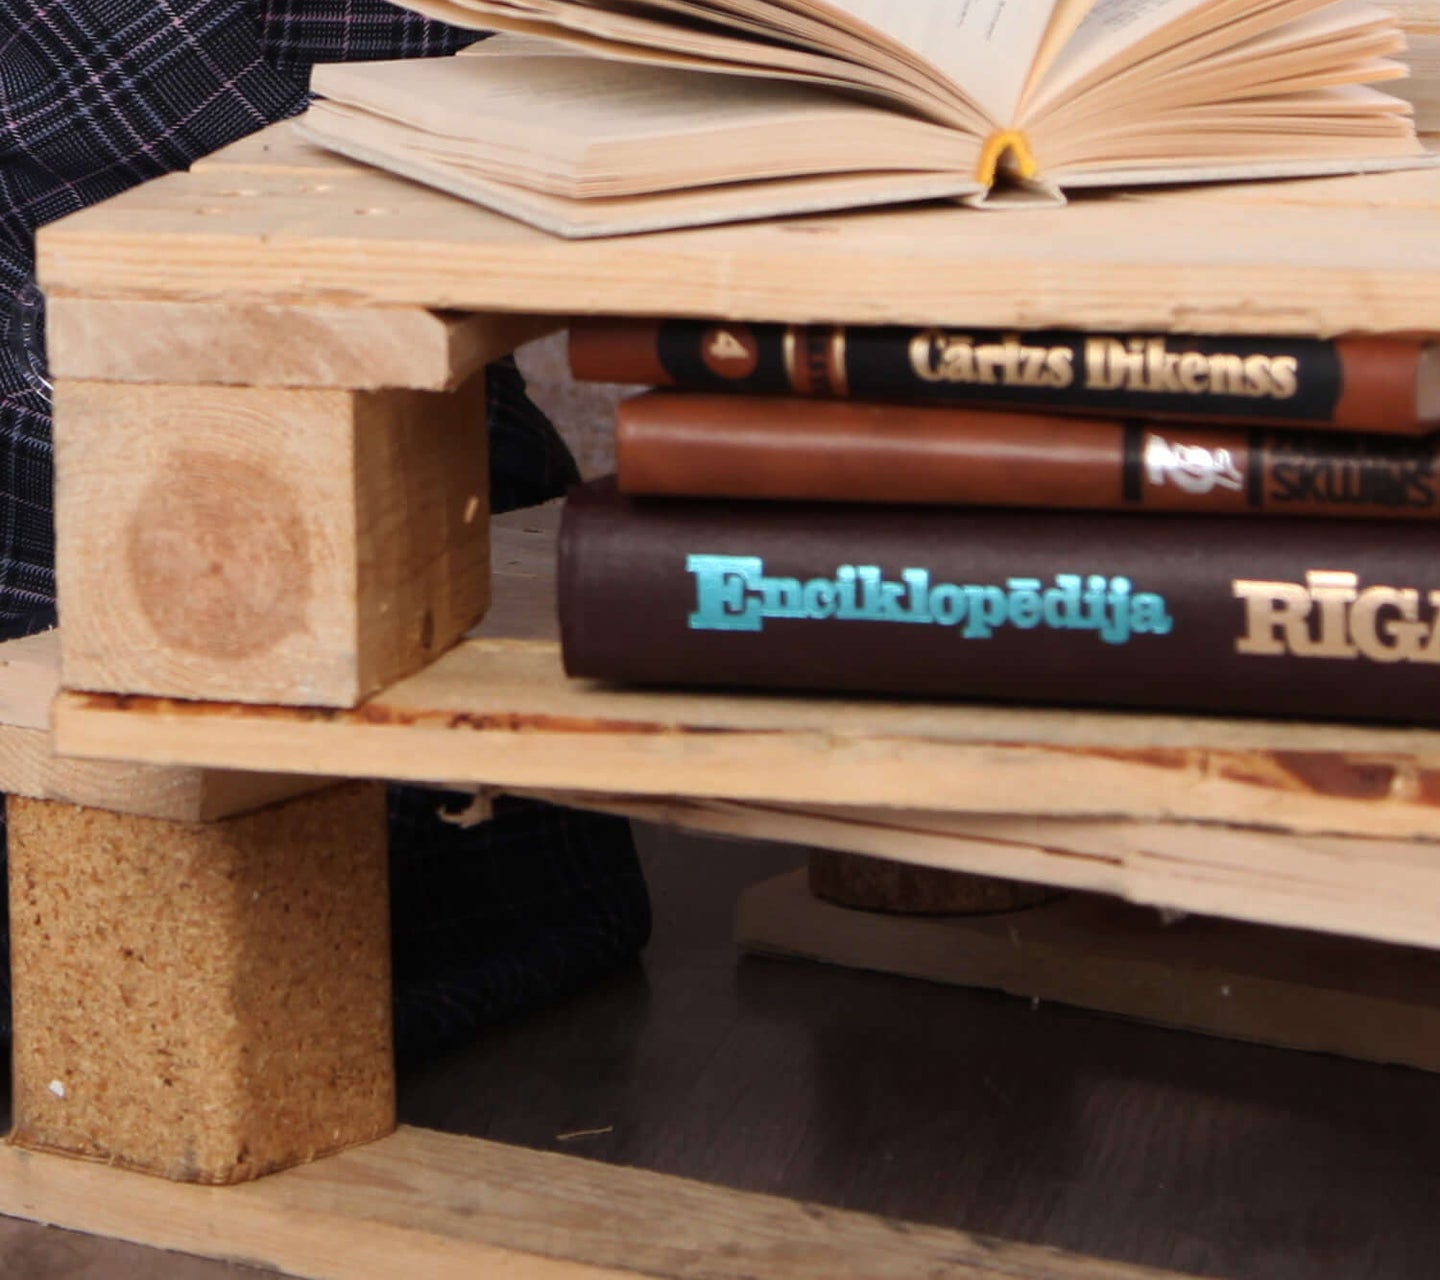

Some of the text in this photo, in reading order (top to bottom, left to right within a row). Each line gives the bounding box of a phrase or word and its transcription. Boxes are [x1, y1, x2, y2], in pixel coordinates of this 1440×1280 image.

[710, 330, 750, 359] 4
[1084, 338, 1298, 398] Dikenss
[686, 554, 1173, 644] Enciklopēdija
